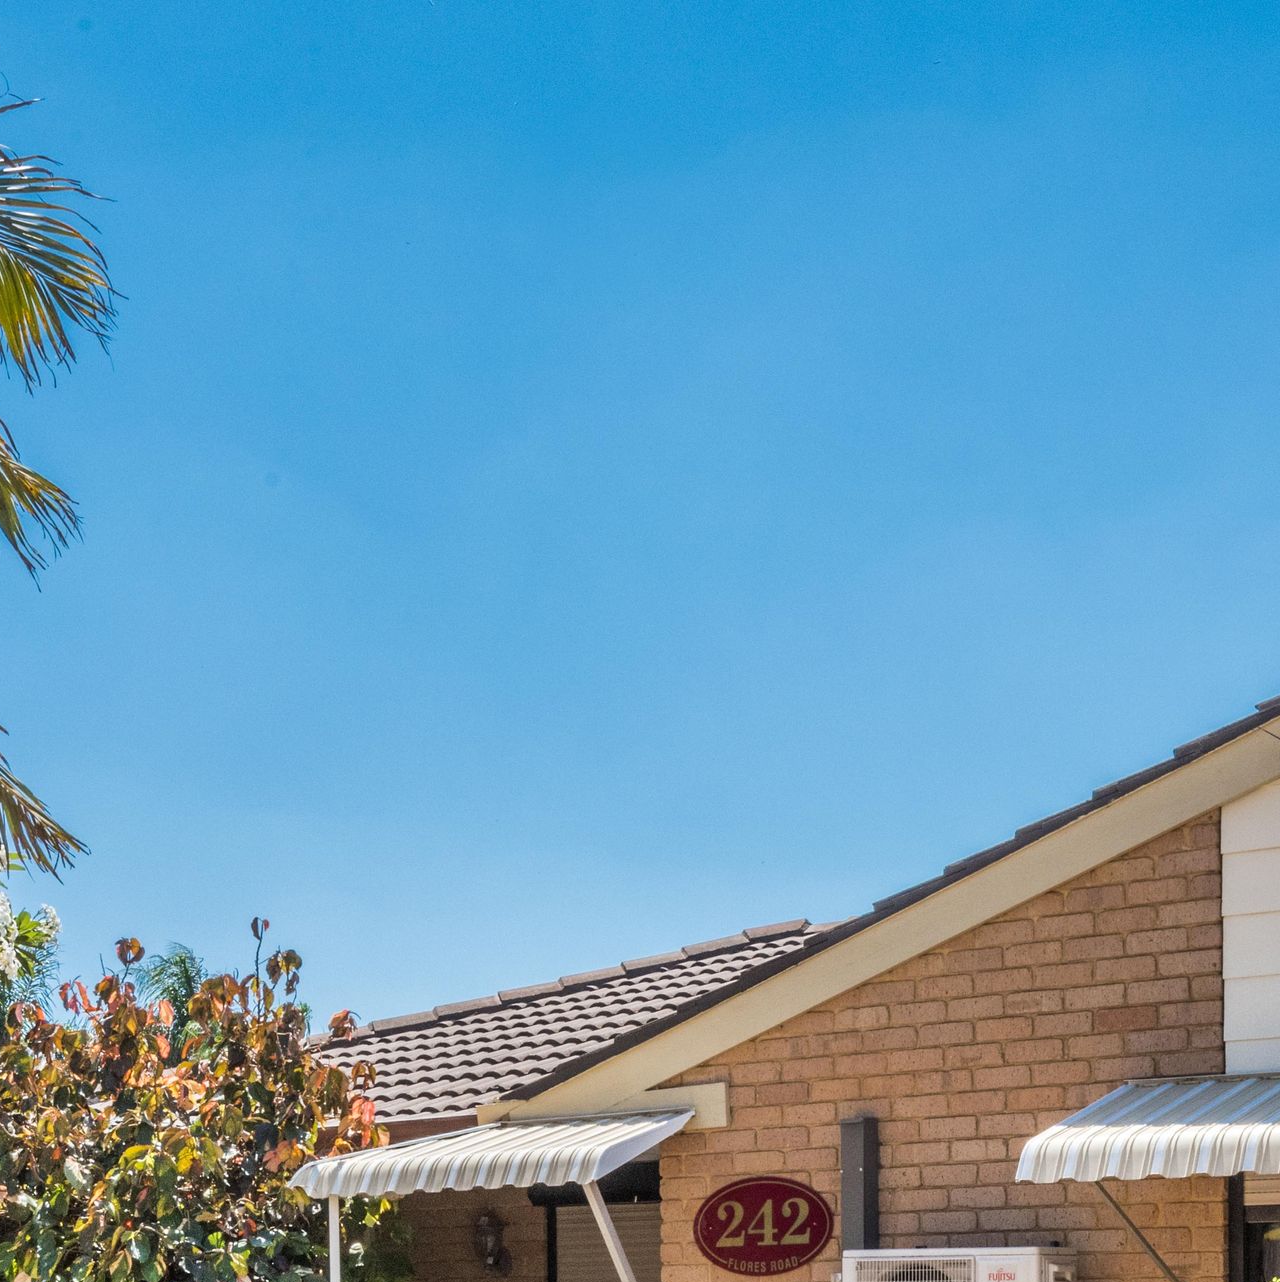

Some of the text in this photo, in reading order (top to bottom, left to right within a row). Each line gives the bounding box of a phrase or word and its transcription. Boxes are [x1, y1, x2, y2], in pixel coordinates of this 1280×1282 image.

[715, 1197, 811, 1248] 242
[728, 1256, 799, 1273] FLORES ROAD
[988, 1271, 1016, 1282] FUJITSU
